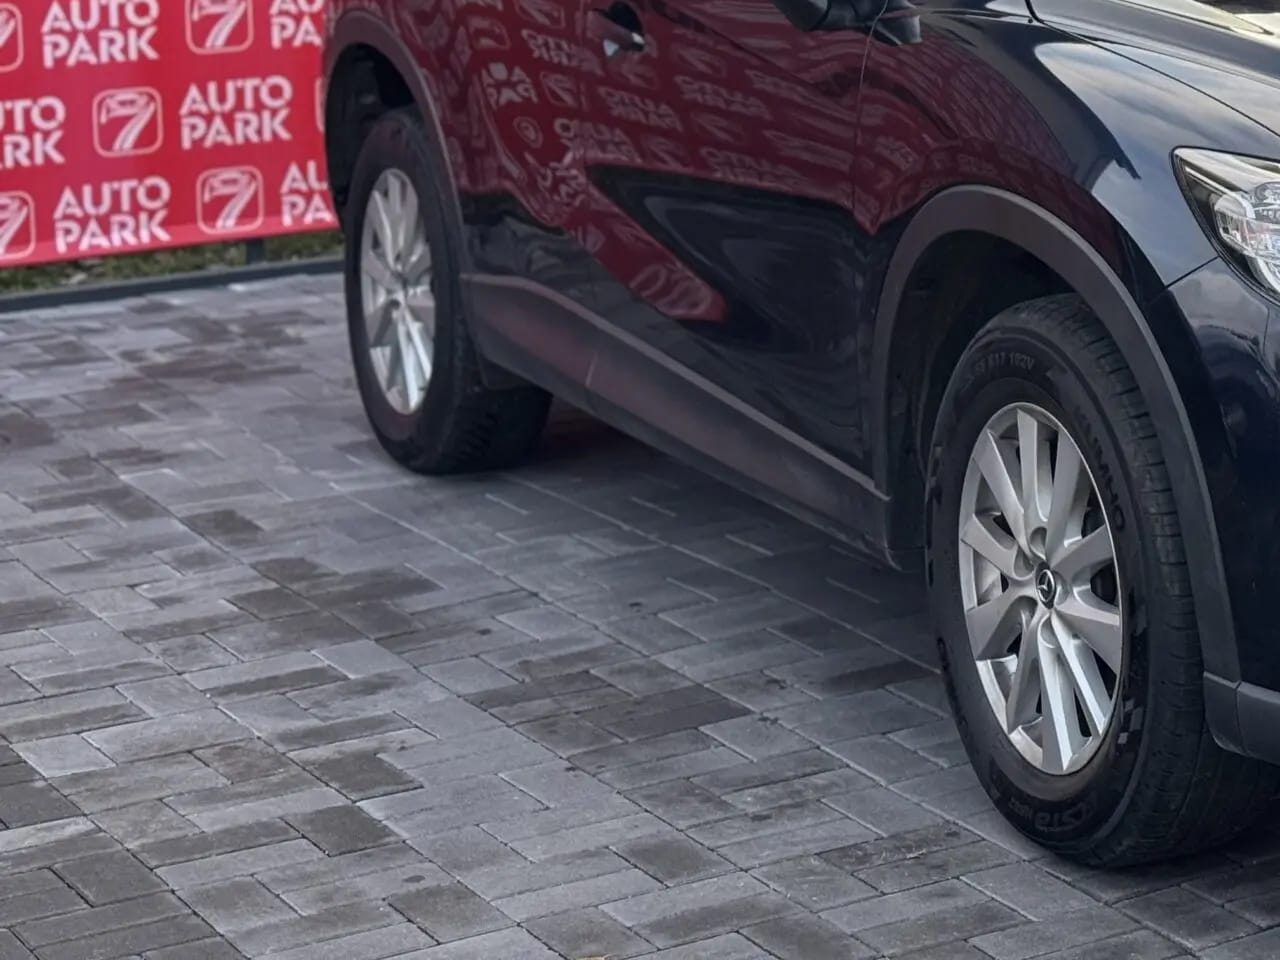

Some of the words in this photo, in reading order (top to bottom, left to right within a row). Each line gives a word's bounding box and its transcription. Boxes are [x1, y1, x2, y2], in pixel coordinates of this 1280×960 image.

[42, 25, 159, 69] PARK
[179, 75, 292, 116] AUTO
[180, 108, 292, 151] PARK
[53, 175, 171, 220] AUTO
[54, 208, 171, 255] PARK
